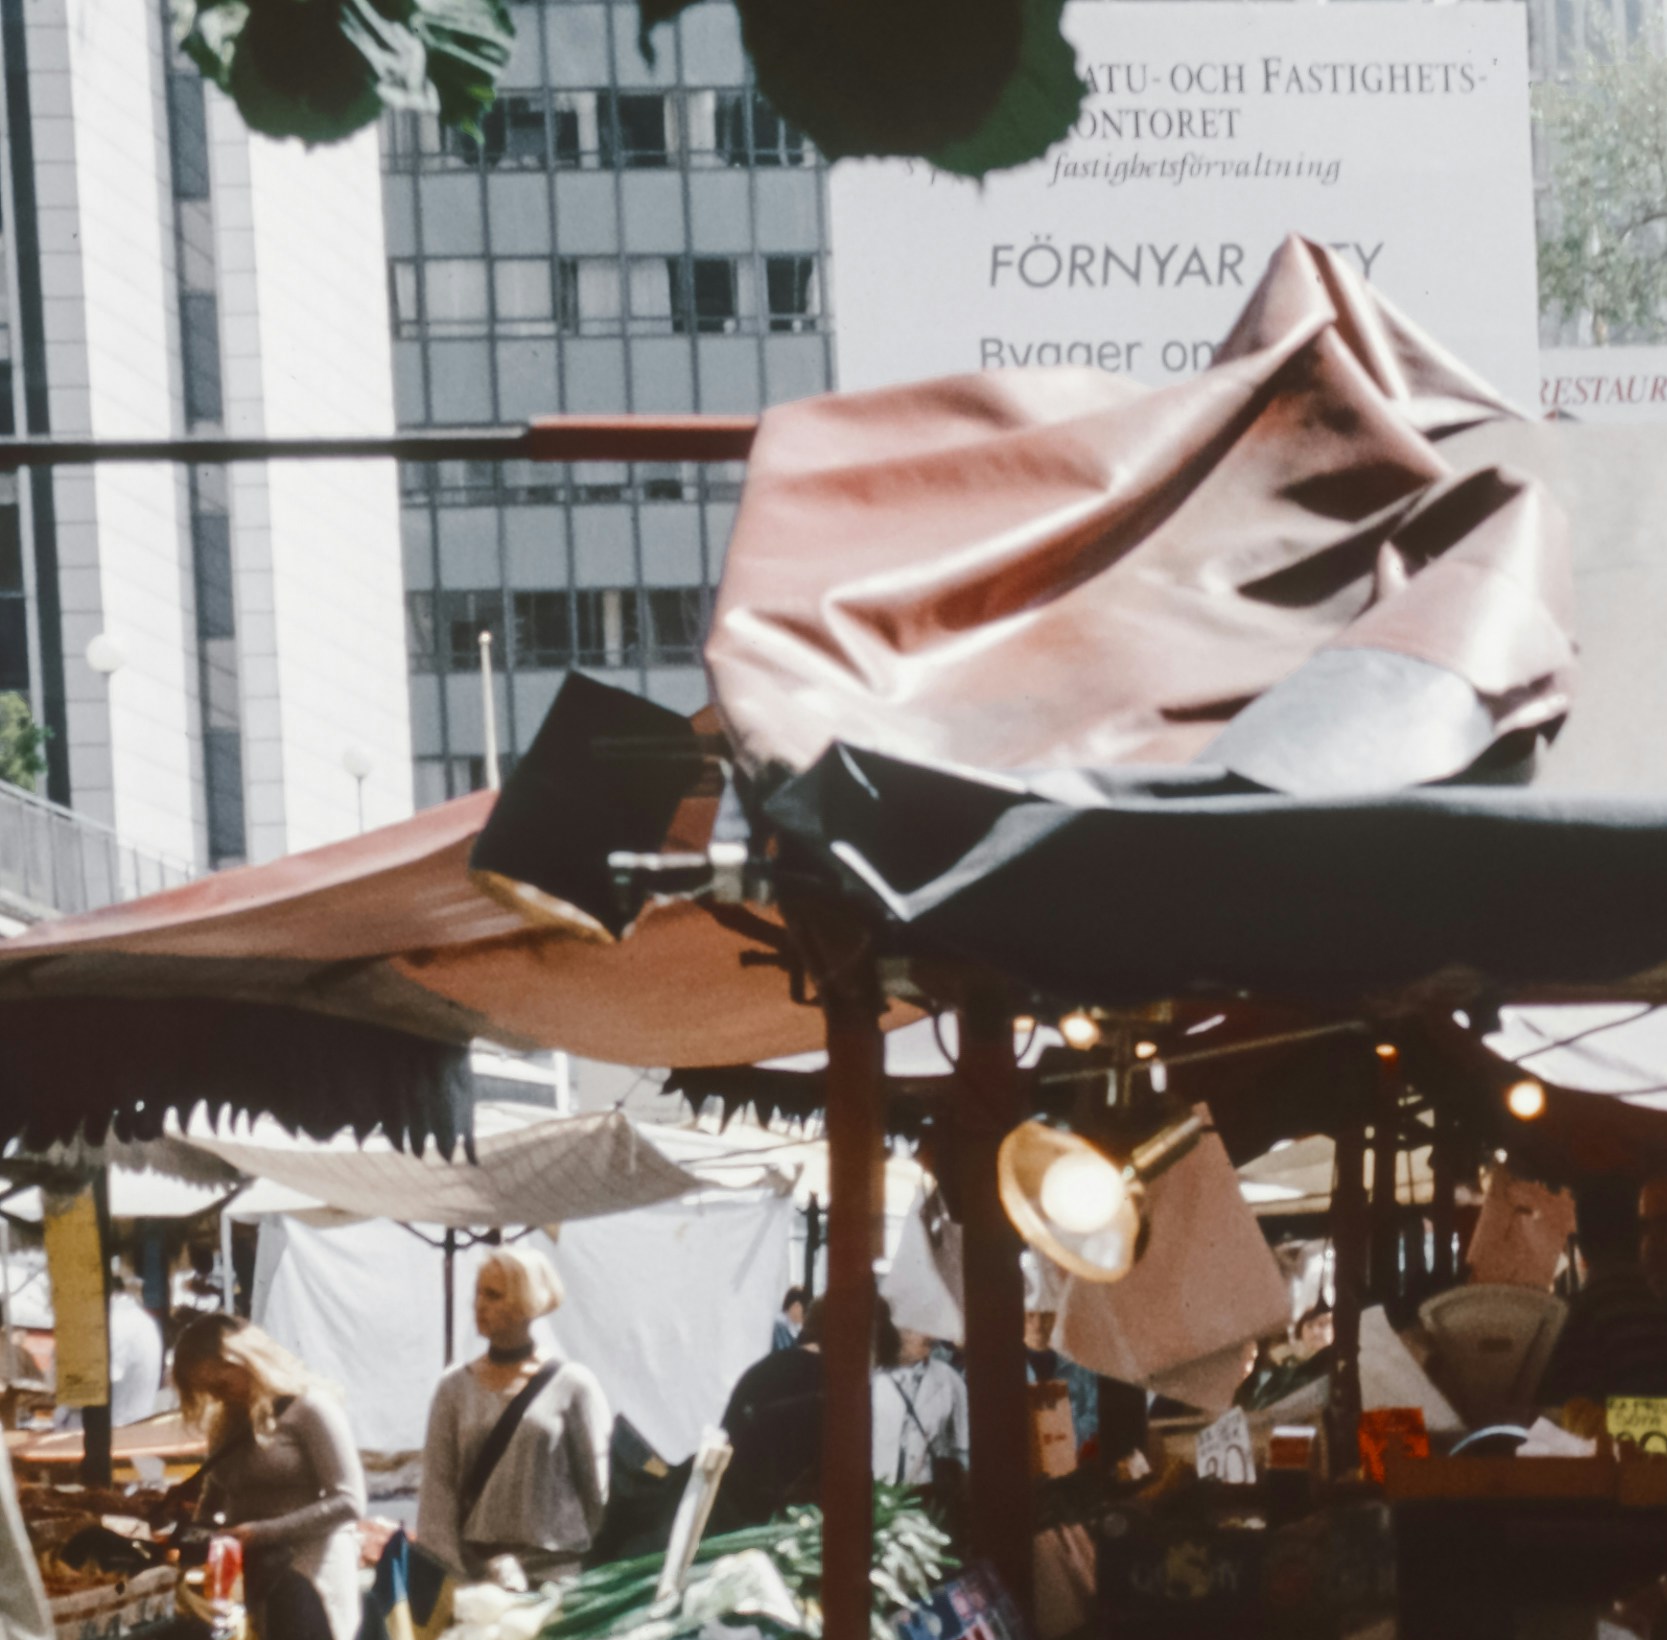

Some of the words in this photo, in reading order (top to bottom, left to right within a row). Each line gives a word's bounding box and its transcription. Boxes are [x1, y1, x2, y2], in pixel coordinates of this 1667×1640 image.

[1169, 63, 1246, 95] OCH
[1074, 108, 1241, 140] ONTORET
[988, 234, 1246, 289] FÖRNYAR
